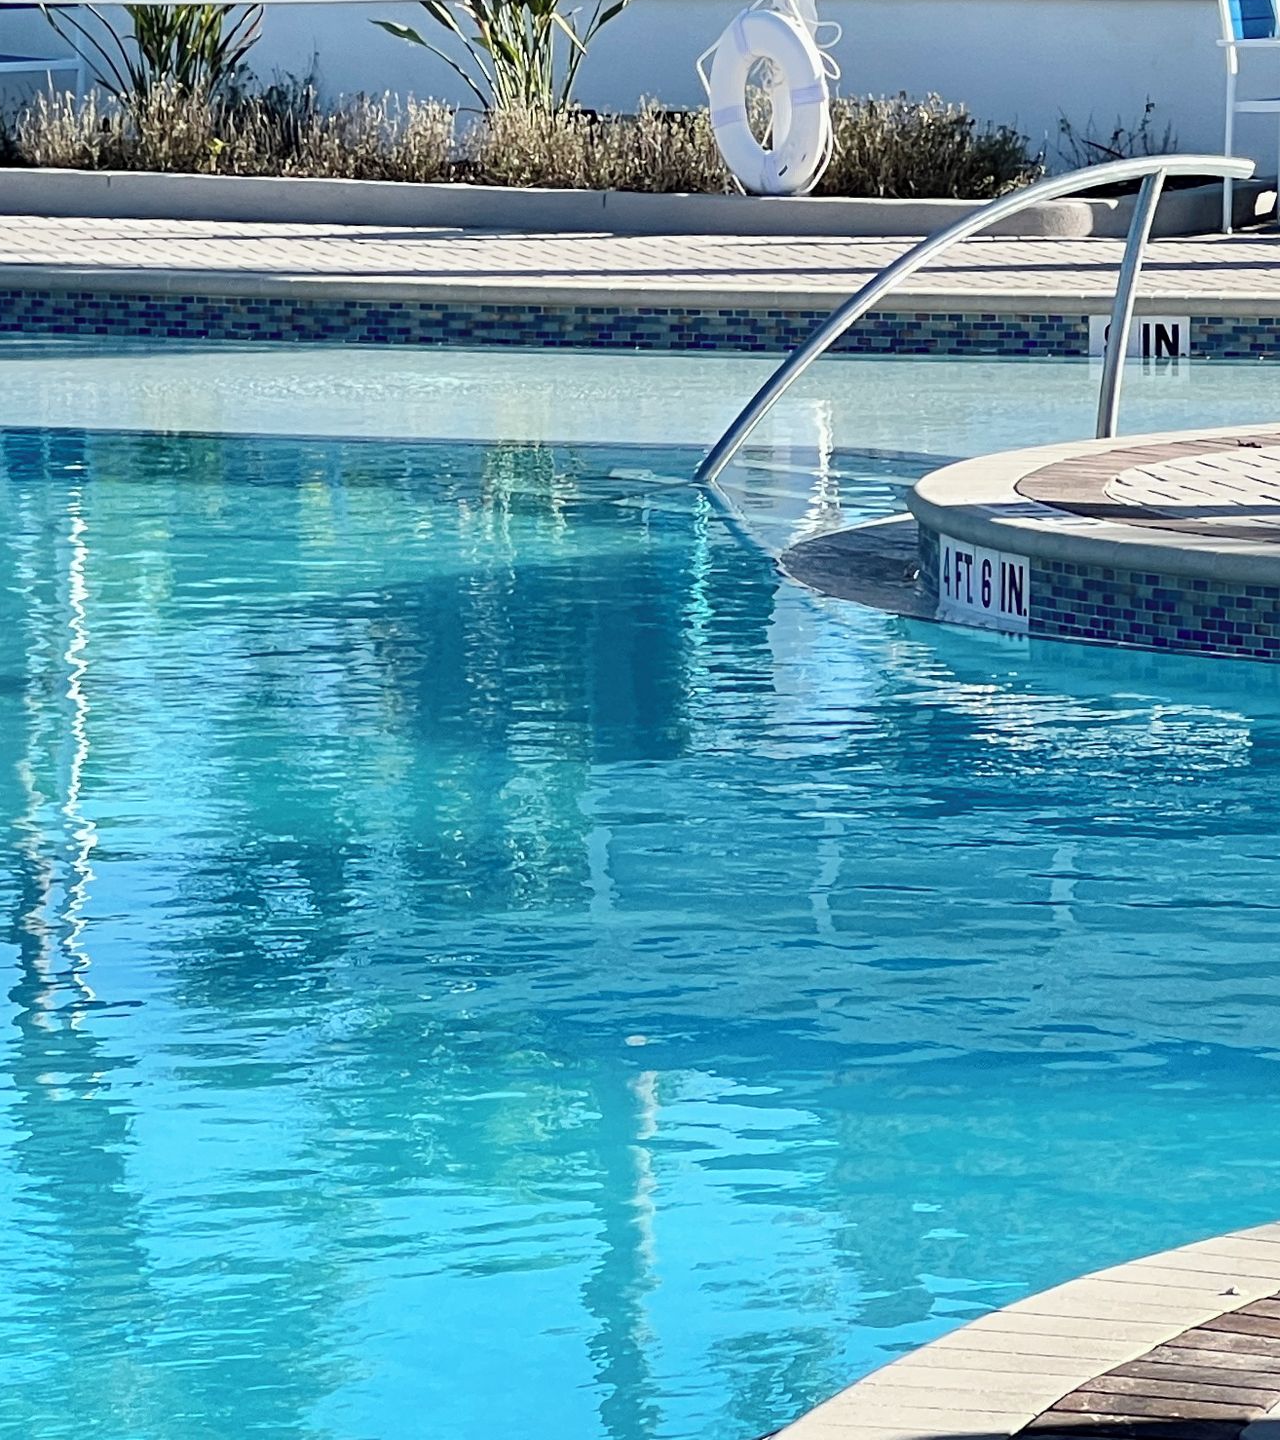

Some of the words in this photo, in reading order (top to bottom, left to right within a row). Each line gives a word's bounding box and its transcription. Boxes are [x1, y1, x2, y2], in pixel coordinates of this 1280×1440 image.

[943, 546, 951, 597] 4
[981, 558, 992, 609] 6
[1000, 561, 1028, 617] IN.
